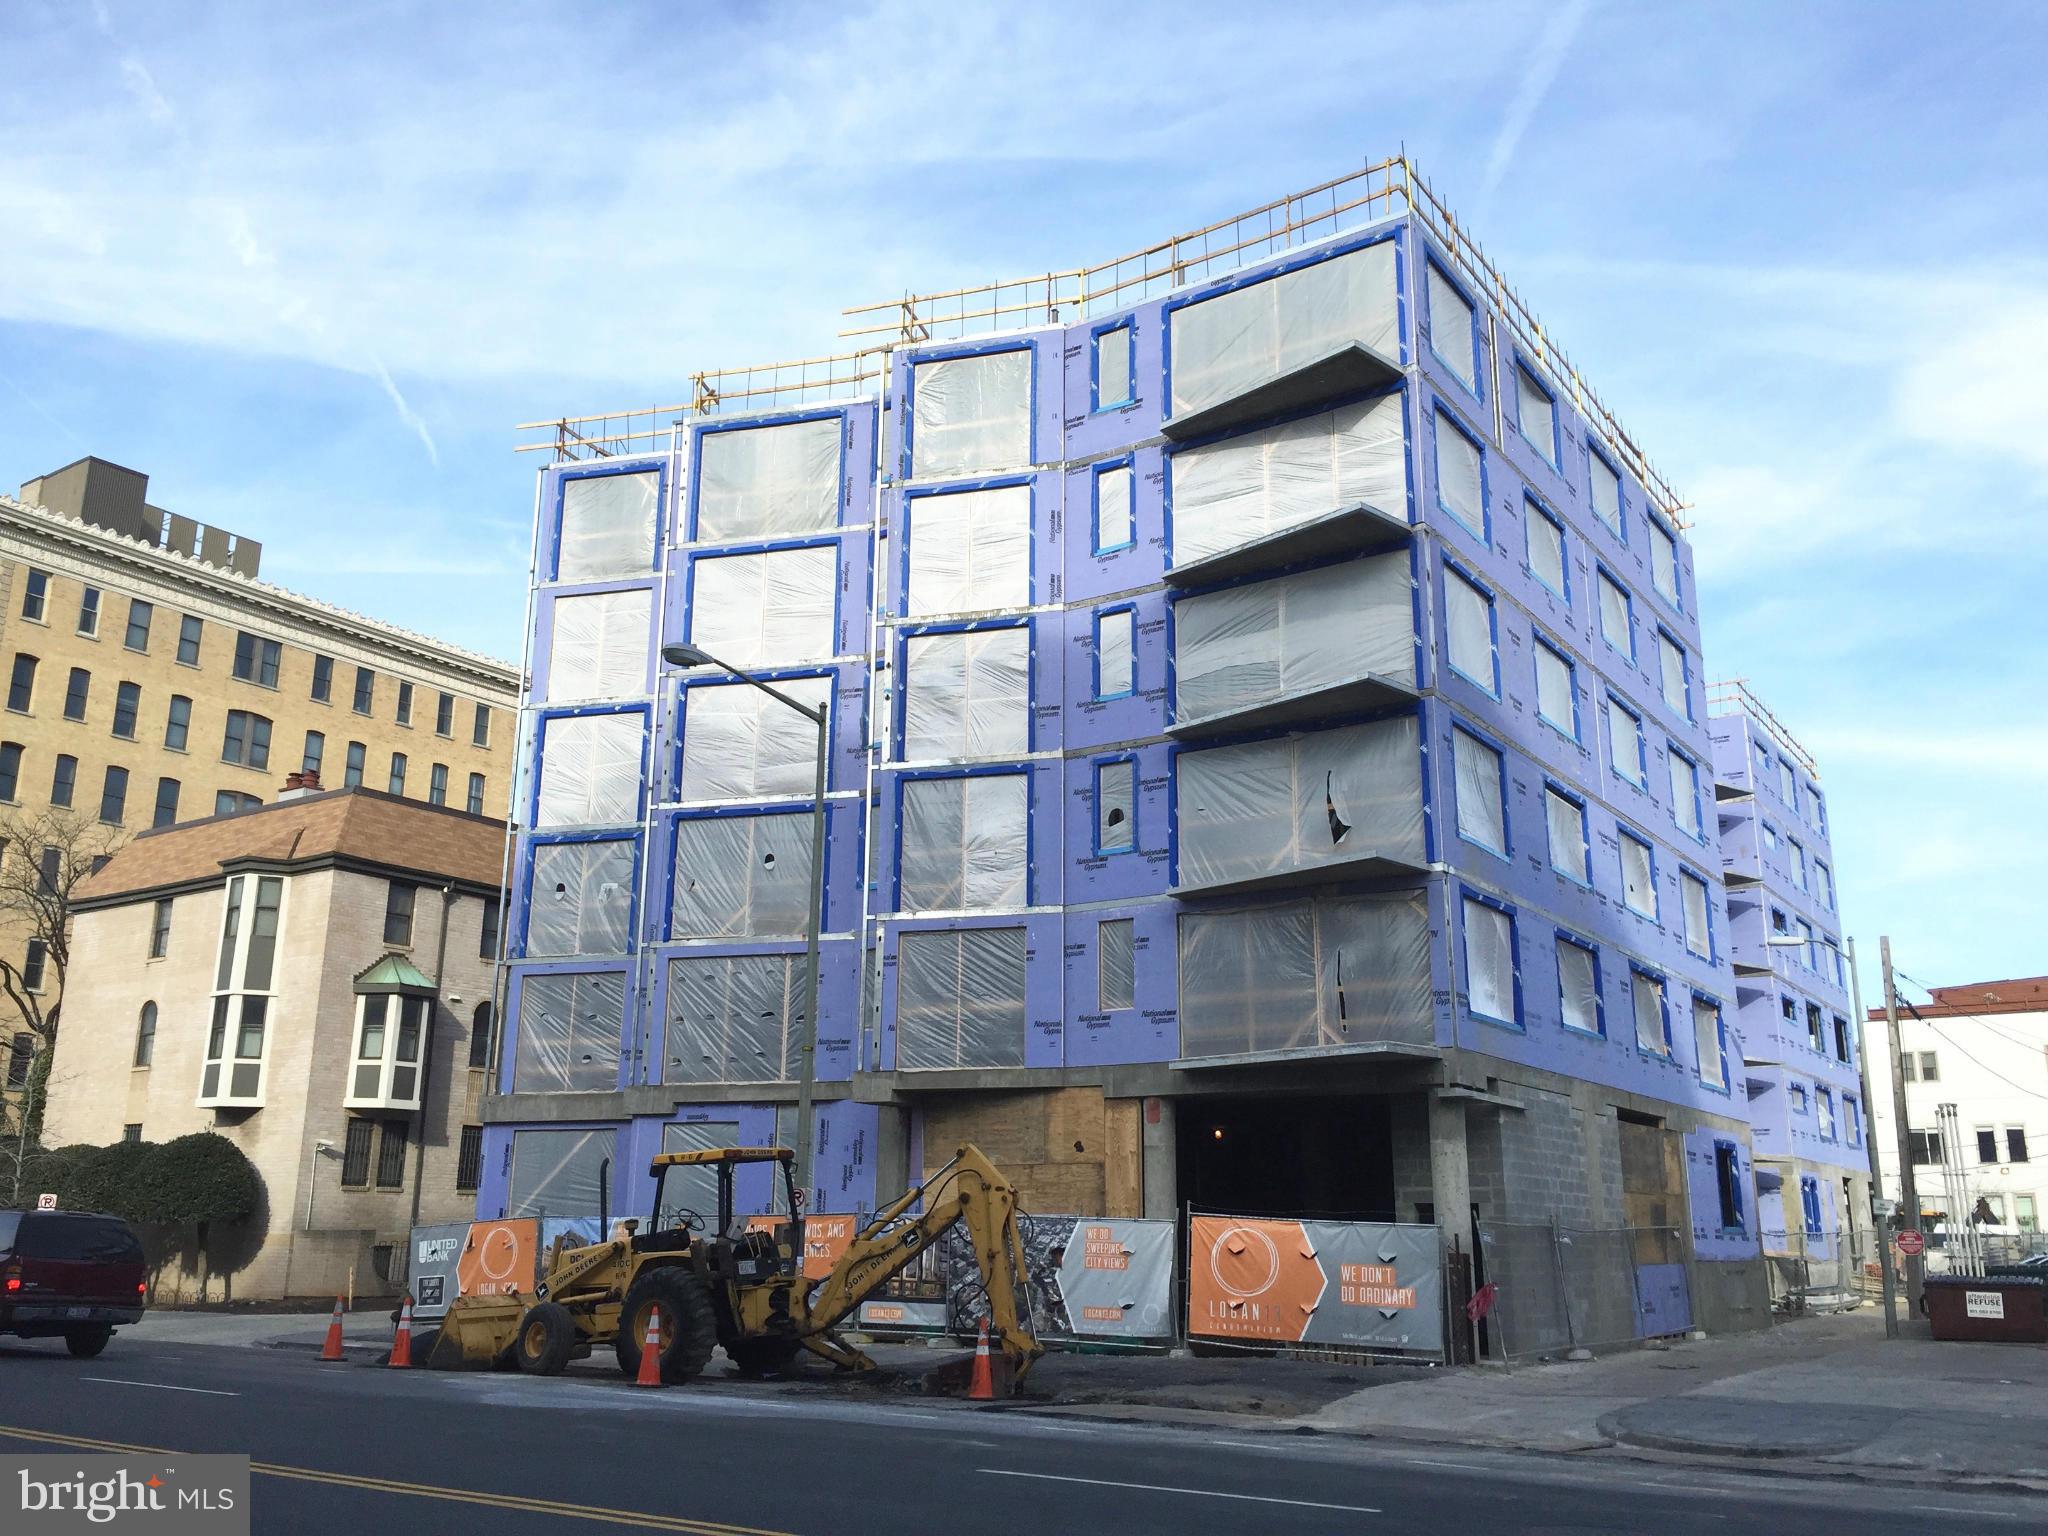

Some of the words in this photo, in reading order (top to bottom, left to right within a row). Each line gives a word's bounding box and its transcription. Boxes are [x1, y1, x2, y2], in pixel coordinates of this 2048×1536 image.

[827, 1223, 845, 1238] AND
[1087, 1228, 1098, 1239] WE
[1100, 1228, 1109, 1239] DO
[427, 1239, 457, 1251] UNITED
[1086, 1242, 1120, 1254] SWEEPING
[427, 1251, 449, 1263] BANK
[1086, 1257, 1102, 1268] CITY
[1104, 1257, 1125, 1269] VIEWS
[554, 1271, 575, 1287] JOHN
[1341, 1265, 1357, 1282] WE
[1361, 1266, 1392, 1284] DON'T
[1341, 1286, 1355, 1302] DO
[1360, 1287, 1413, 1305] ORDINARY
[1967, 1298, 2001, 1306] REFUSE
